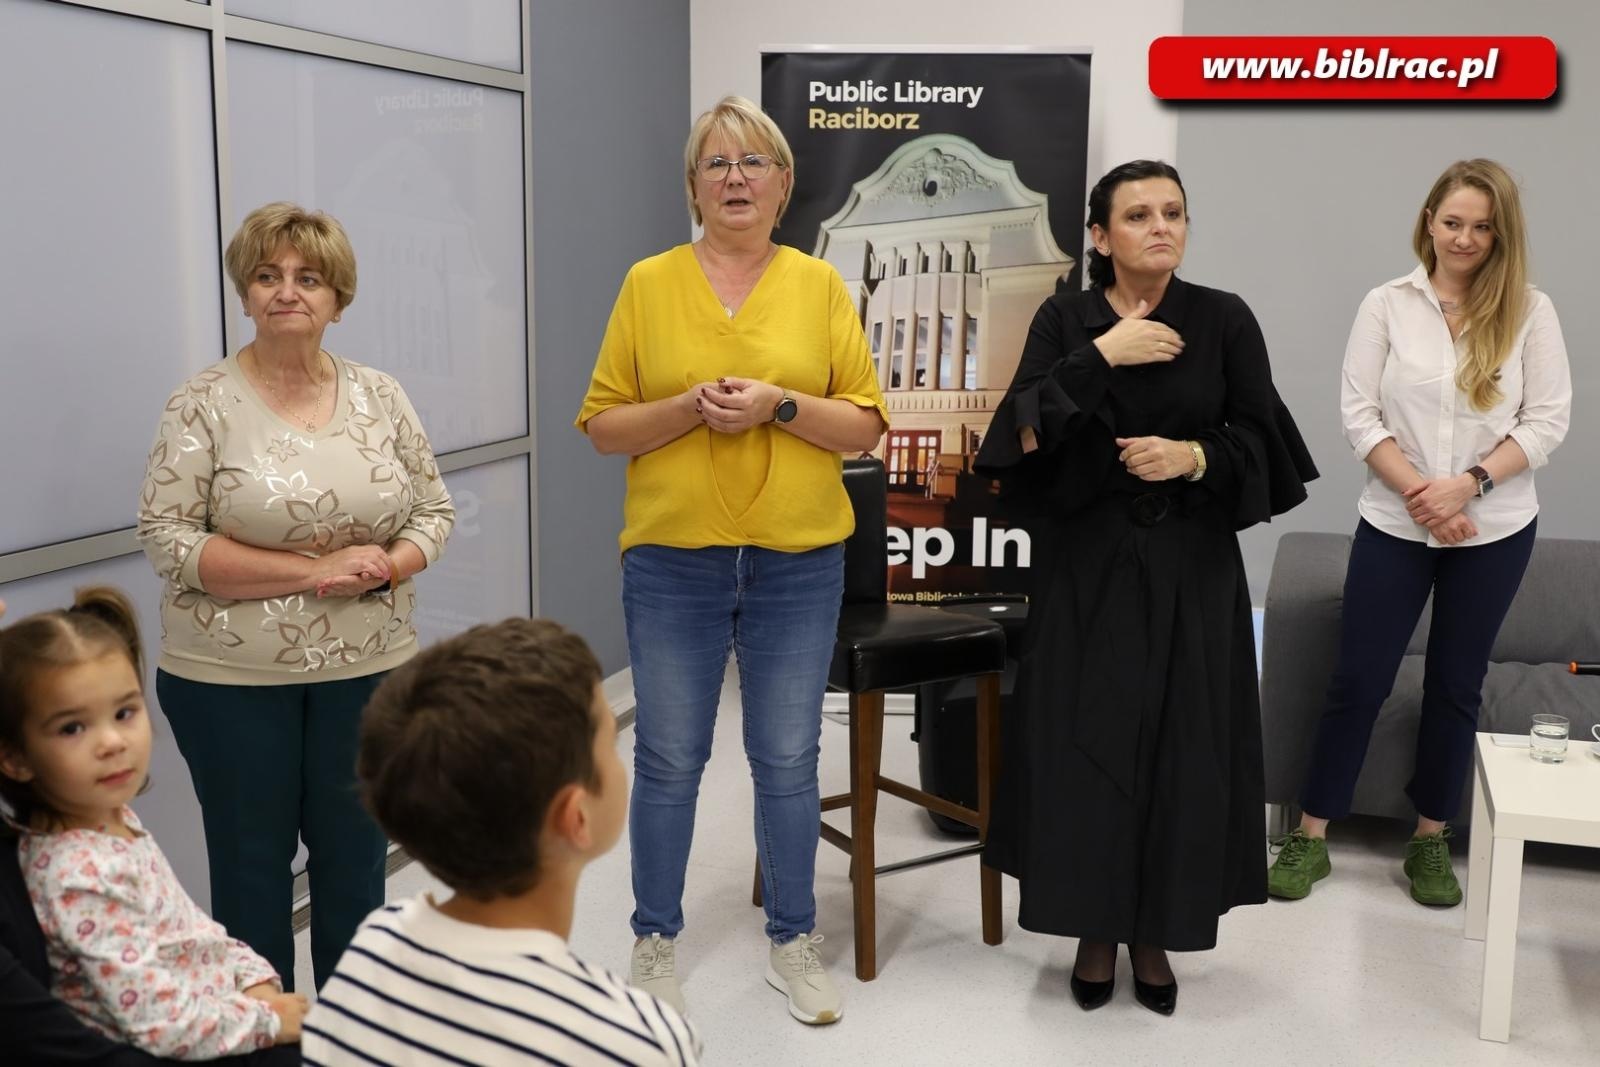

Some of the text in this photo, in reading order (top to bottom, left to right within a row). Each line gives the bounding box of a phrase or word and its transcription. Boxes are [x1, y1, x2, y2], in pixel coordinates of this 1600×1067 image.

[809, 80, 984, 109] Public Library
[809, 107, 920, 130] Raciborz
[972, 517, 1031, 567] In
